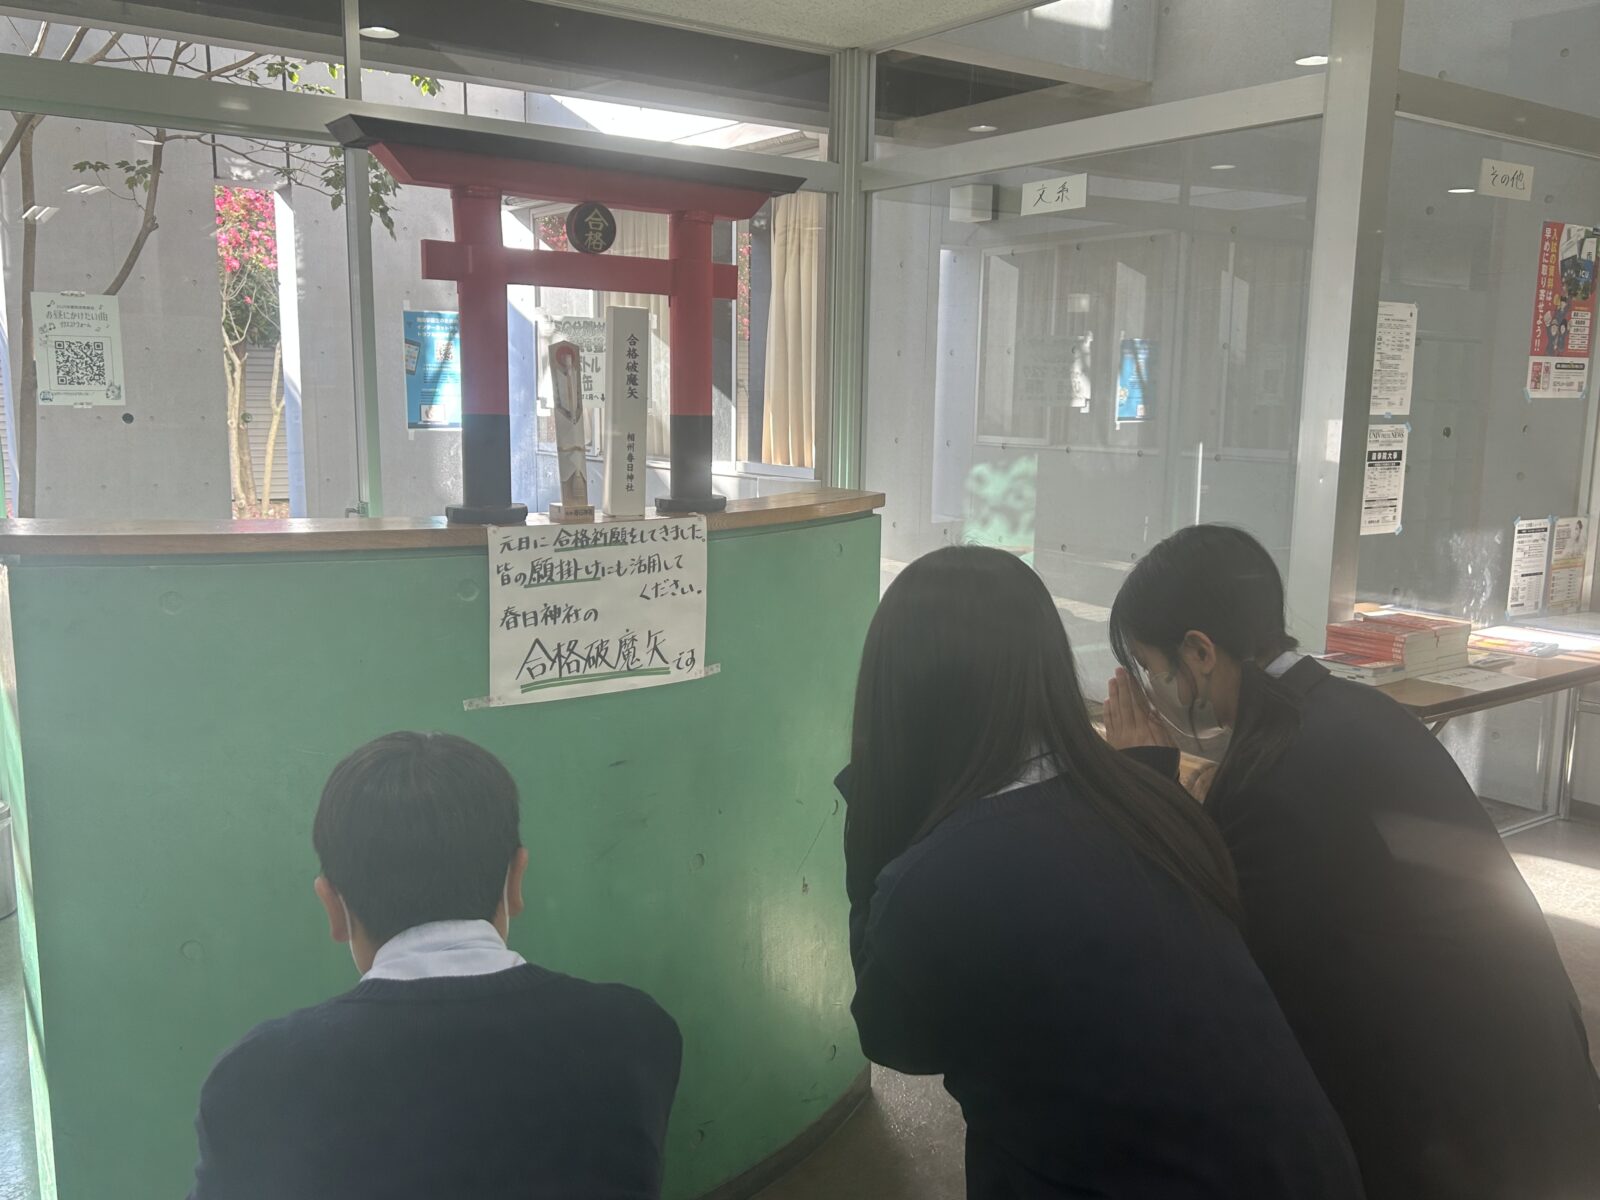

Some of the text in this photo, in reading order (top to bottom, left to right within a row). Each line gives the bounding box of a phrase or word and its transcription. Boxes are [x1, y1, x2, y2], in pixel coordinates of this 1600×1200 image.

[1490, 165, 1525, 191] その他
[1033, 181, 1070, 208] 文系
[584, 208, 609, 250] 合格
[625, 333, 639, 399] 合格破魔矢
[496, 553, 684, 586] 皆の願掛けにも活用して
[500, 602, 599, 631] 春日神社の
